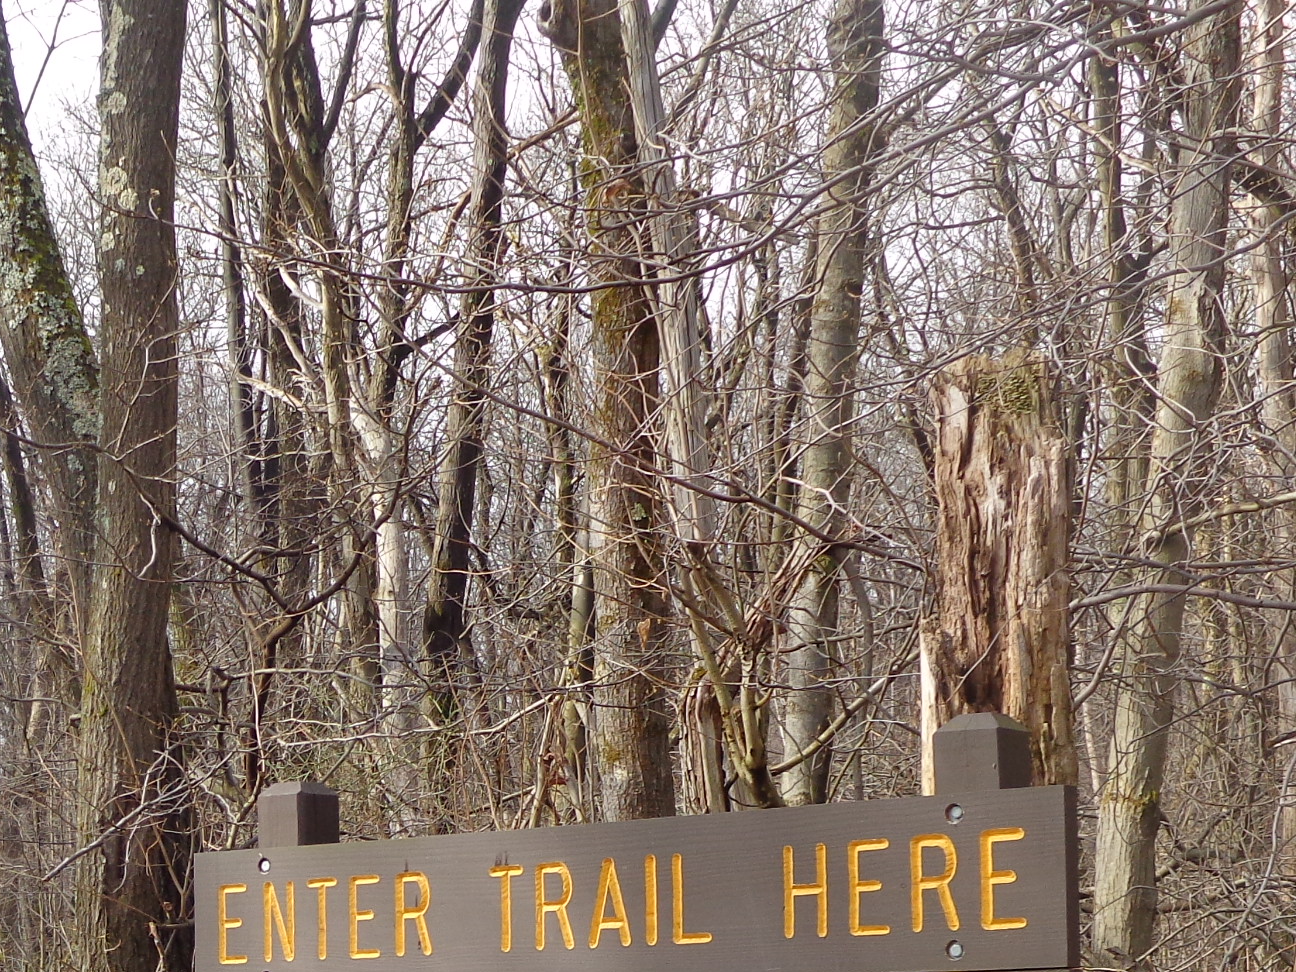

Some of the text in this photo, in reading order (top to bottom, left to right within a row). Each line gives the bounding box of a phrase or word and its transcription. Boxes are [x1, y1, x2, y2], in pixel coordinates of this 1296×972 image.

[218, 827, 1028, 965] ENTER TRAIL HERE
